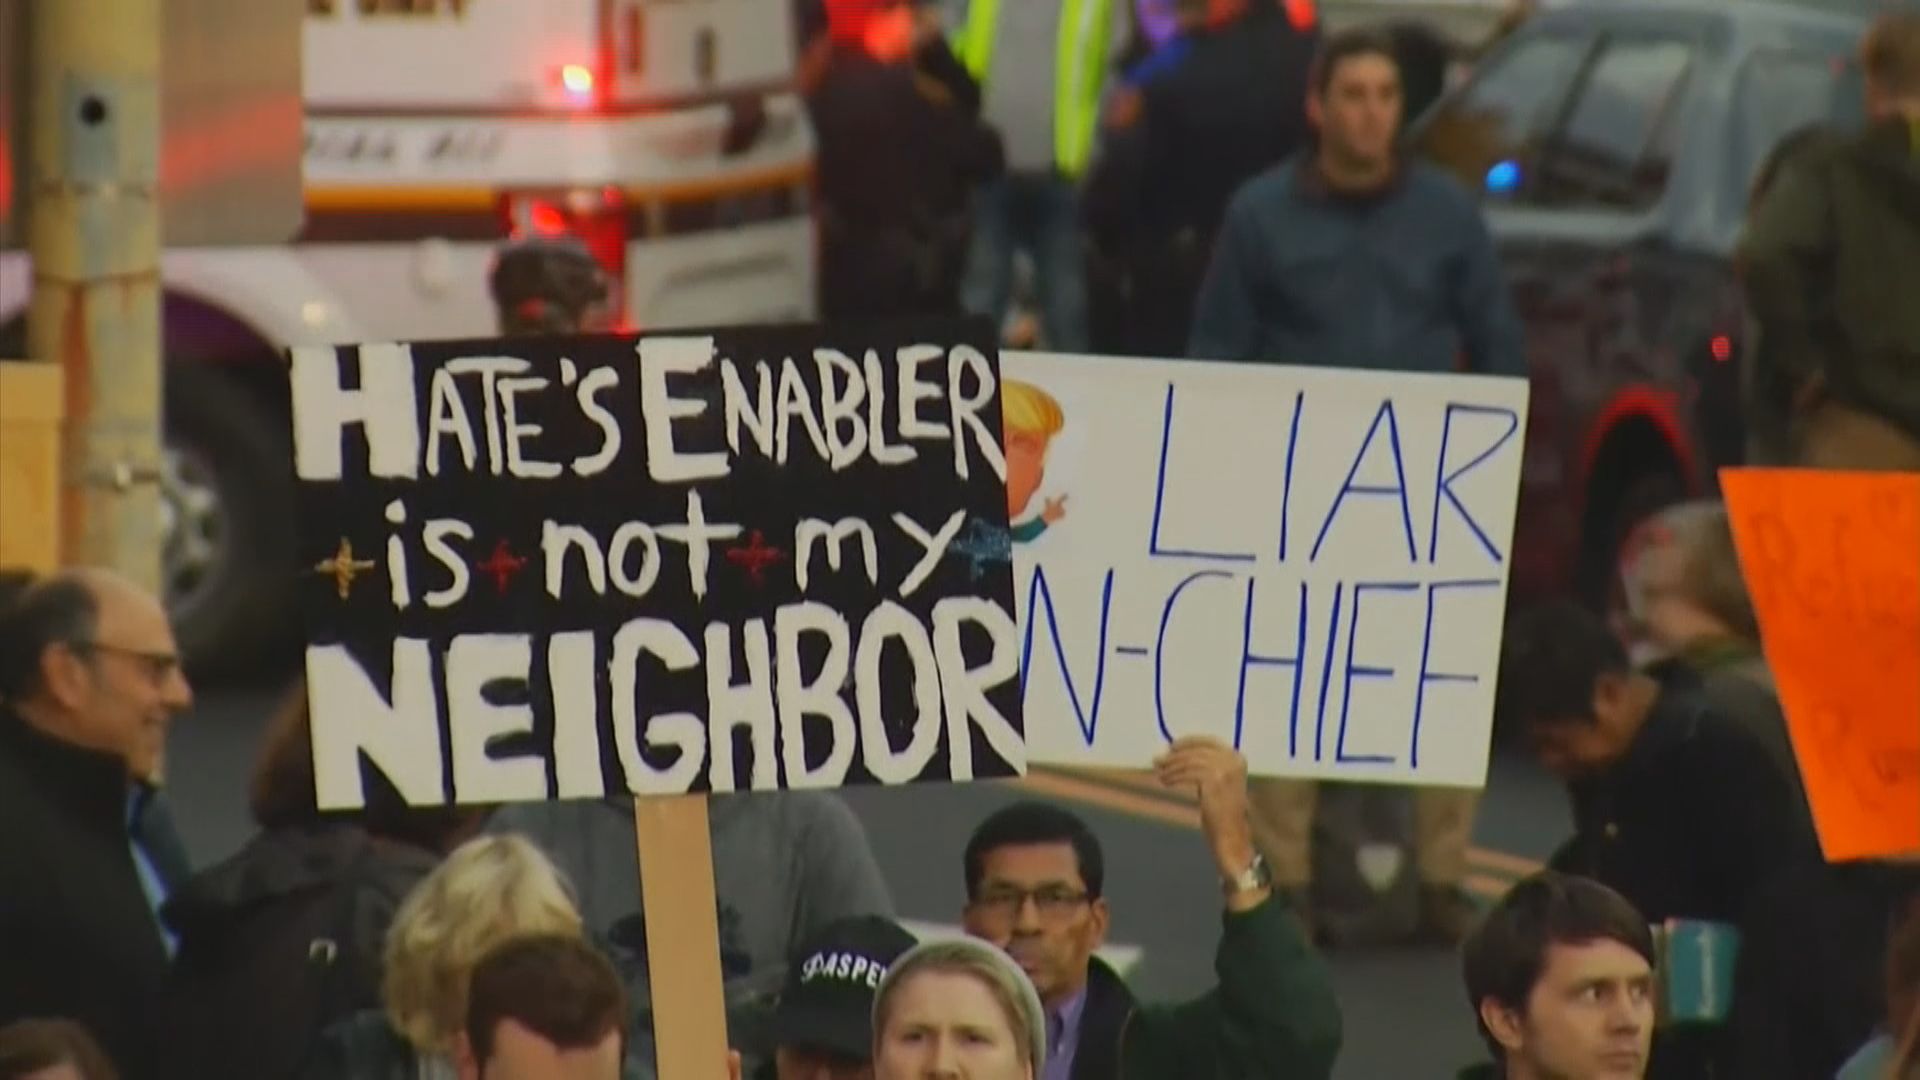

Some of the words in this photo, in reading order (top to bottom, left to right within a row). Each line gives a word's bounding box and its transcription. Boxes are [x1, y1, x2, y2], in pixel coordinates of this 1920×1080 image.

[290, 342, 621, 481] HATE'S
[637, 336, 1007, 483] ENABLER
[1150, 381, 1519, 563] LIAR
[385, 498, 475, 611] is
[542, 488, 743, 602] not
[794, 509, 967, 597] my
[305, 597, 1027, 811] NEIGHBOR
